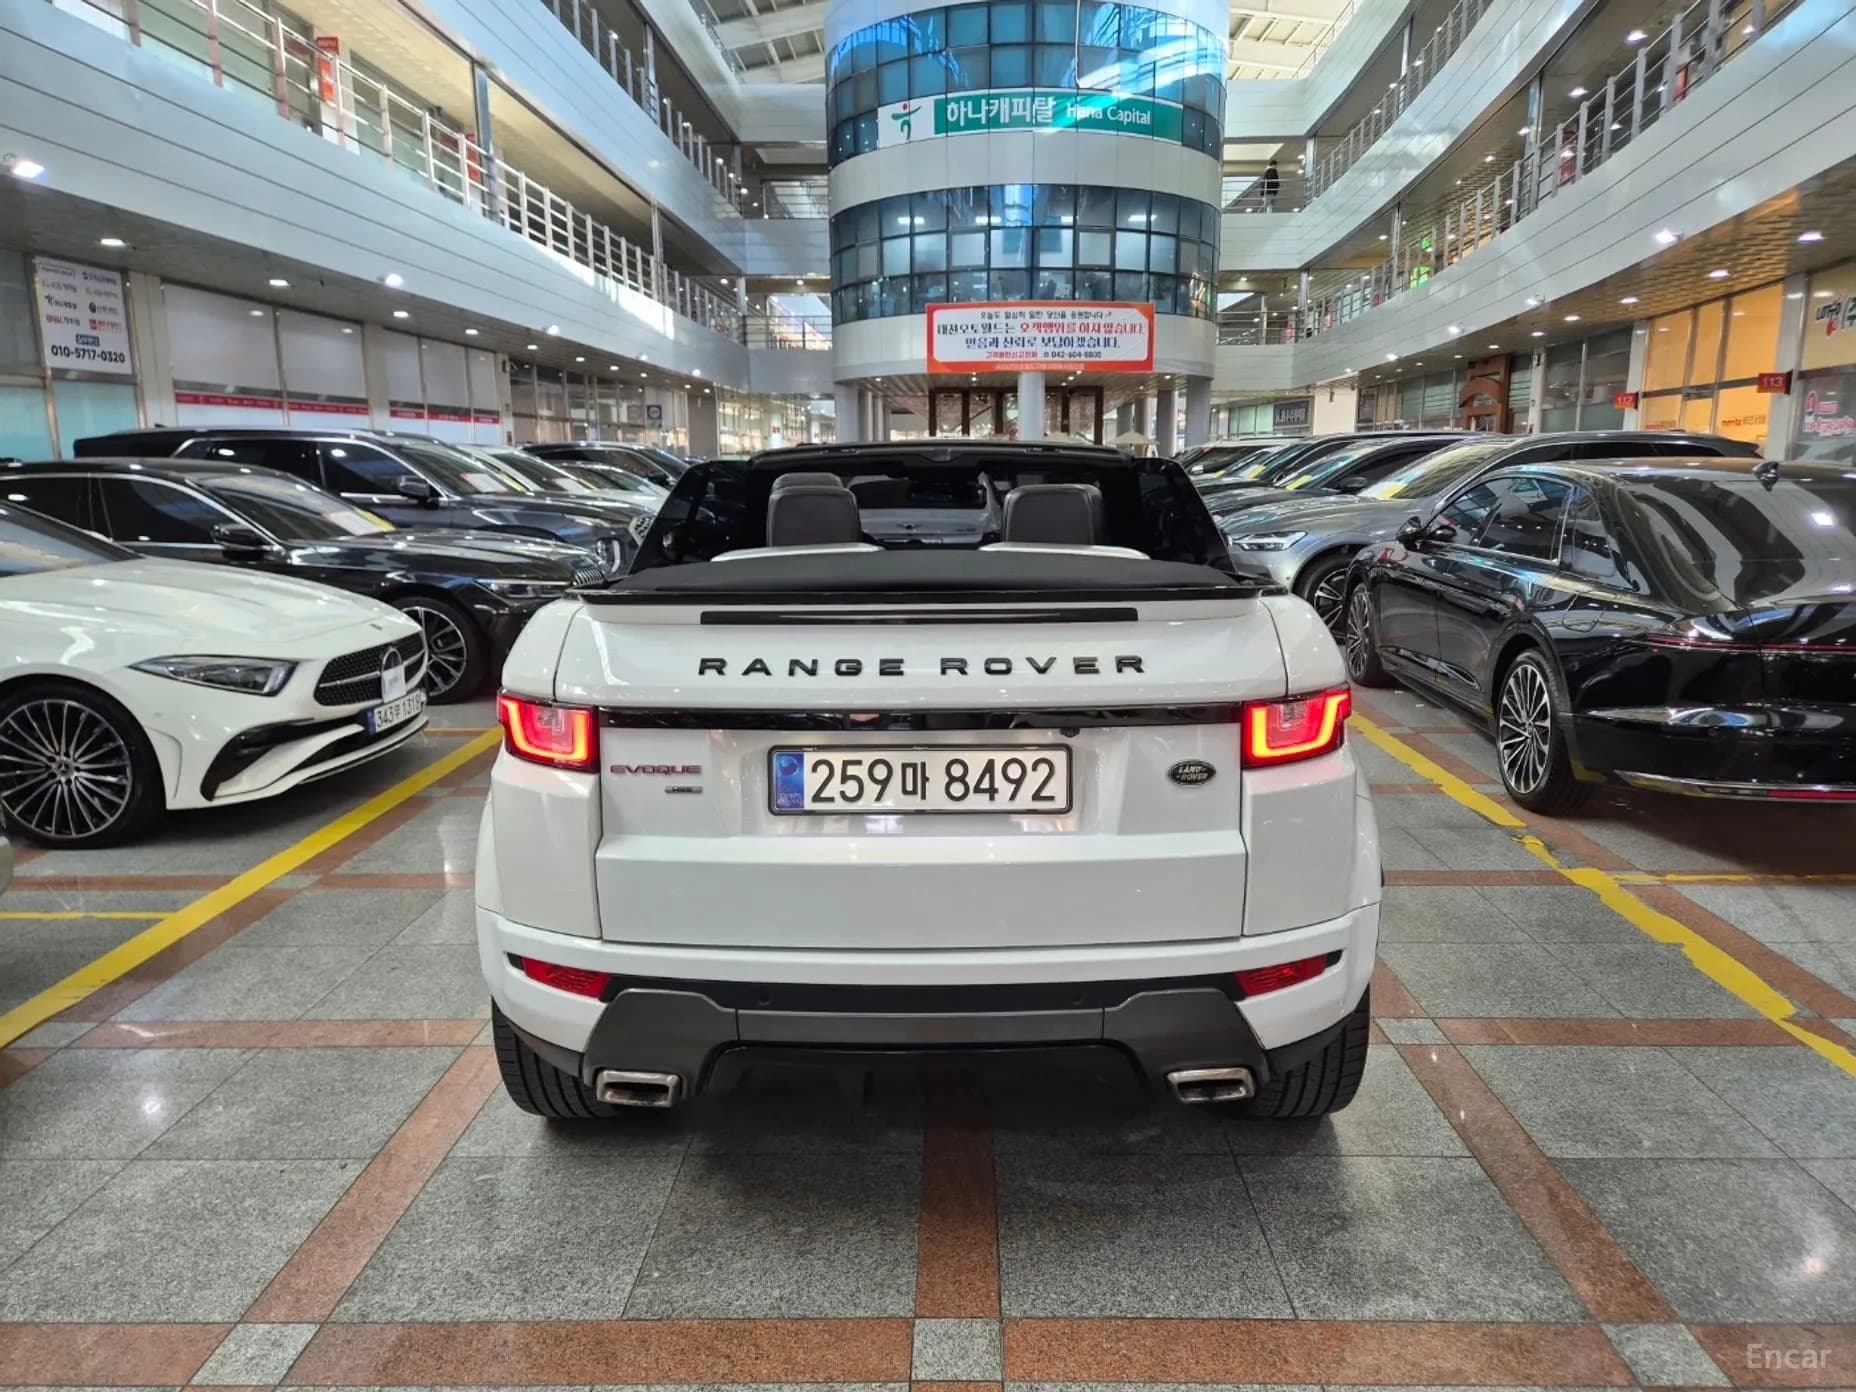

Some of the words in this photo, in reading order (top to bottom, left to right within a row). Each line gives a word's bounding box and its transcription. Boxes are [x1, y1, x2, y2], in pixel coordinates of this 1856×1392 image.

[946, 96, 1056, 126] 하나캐피탈
[1066, 103, 1103, 120] Hana
[1107, 106, 1150, 125] Capital
[51, 345, 125, 363] 010-5717-0320
[1763, 376, 1784, 387] 113
[1617, 396, 1633, 405] 112
[699, 658, 905, 676] RANGE
[940, 656, 1145, 676] ROVER
[610, 765, 703, 776] EVOQUE
[811, 758, 930, 803] 259마
[945, 757, 1056, 802] 8492
